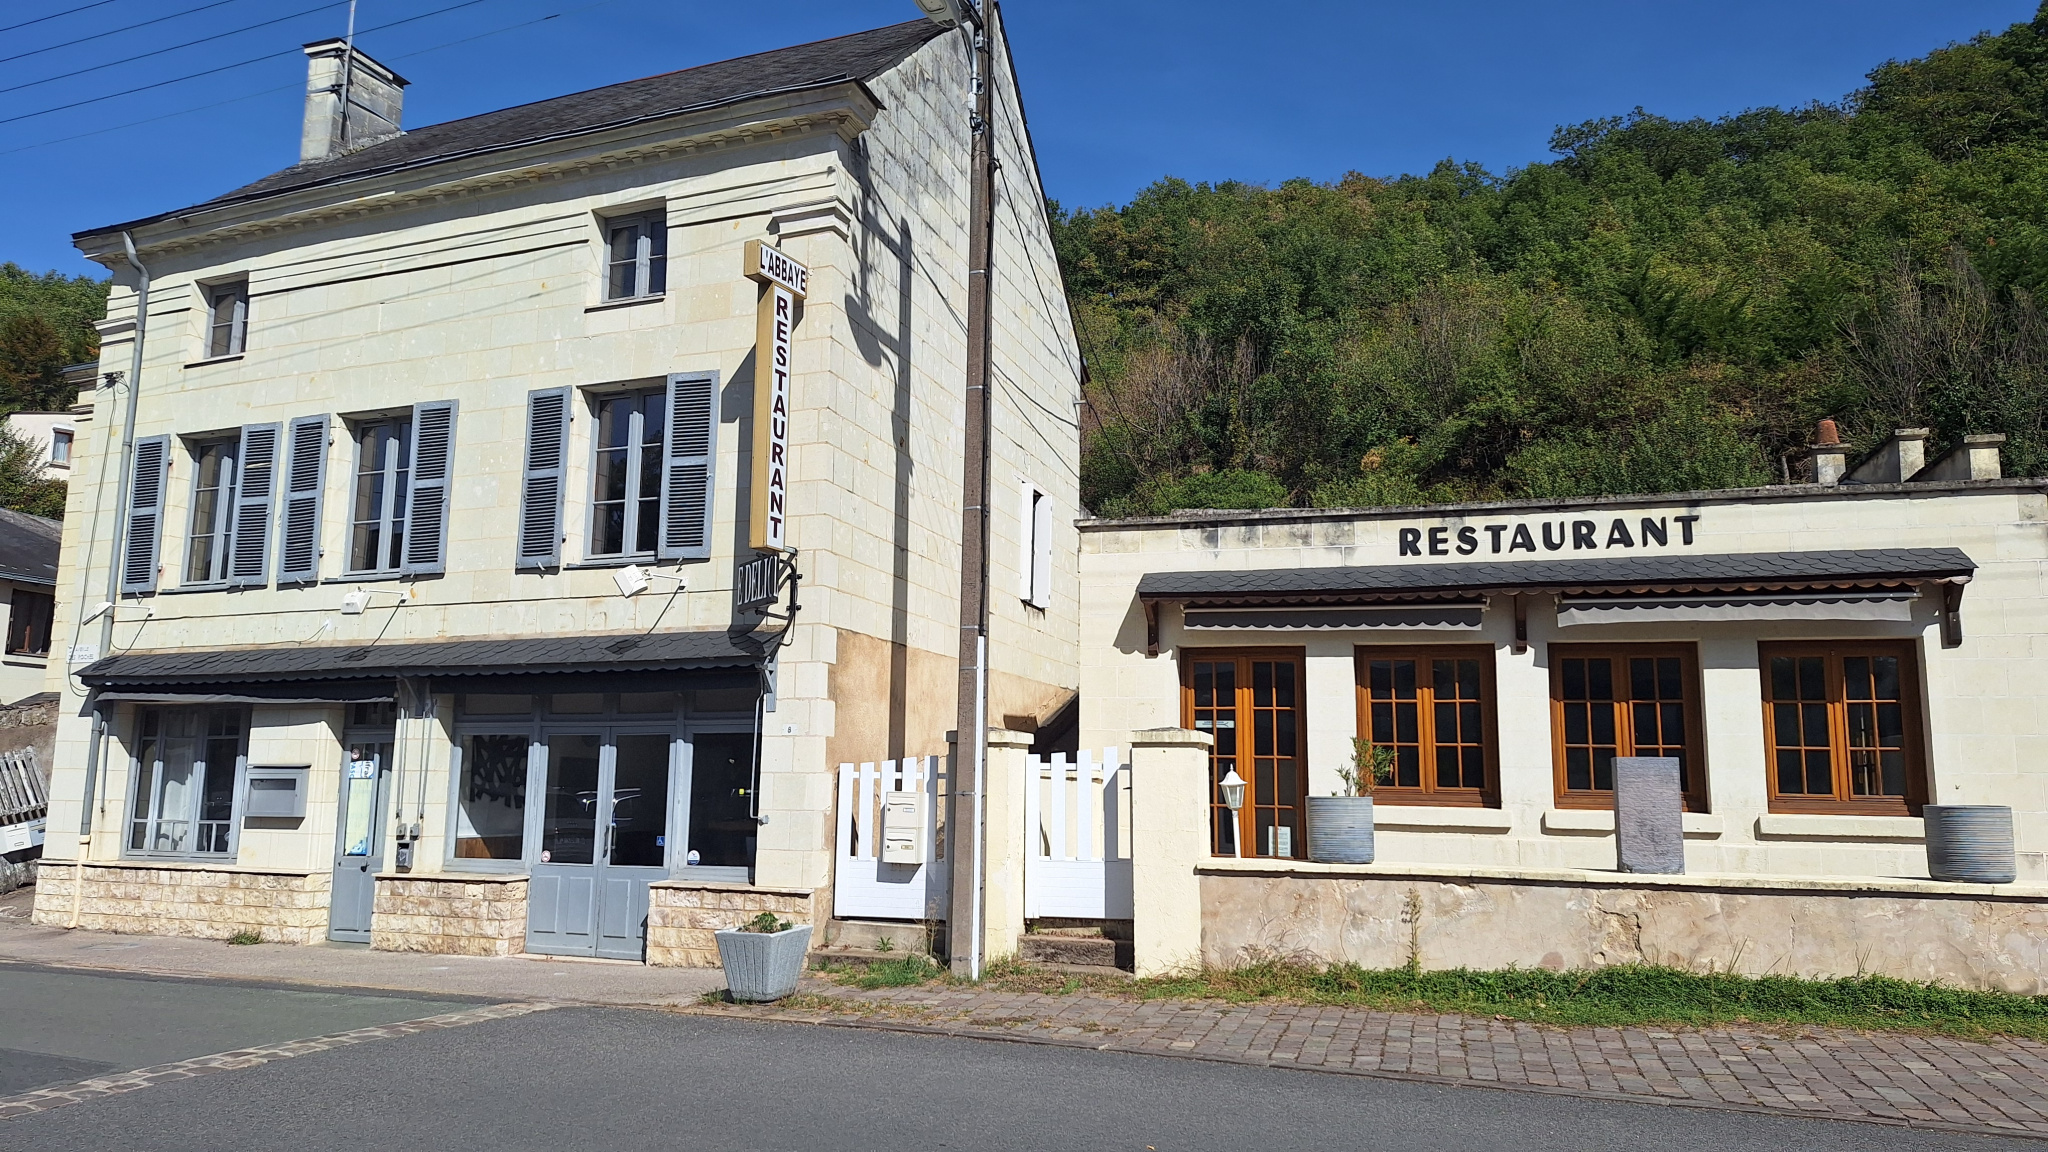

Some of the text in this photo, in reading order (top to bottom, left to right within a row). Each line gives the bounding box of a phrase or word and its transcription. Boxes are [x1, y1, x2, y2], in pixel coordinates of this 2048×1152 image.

[760, 246, 806, 293] L'ABBAYE
[769, 294, 789, 539] RESTAURANT
[1399, 515, 1700, 557] RESTAURANT
